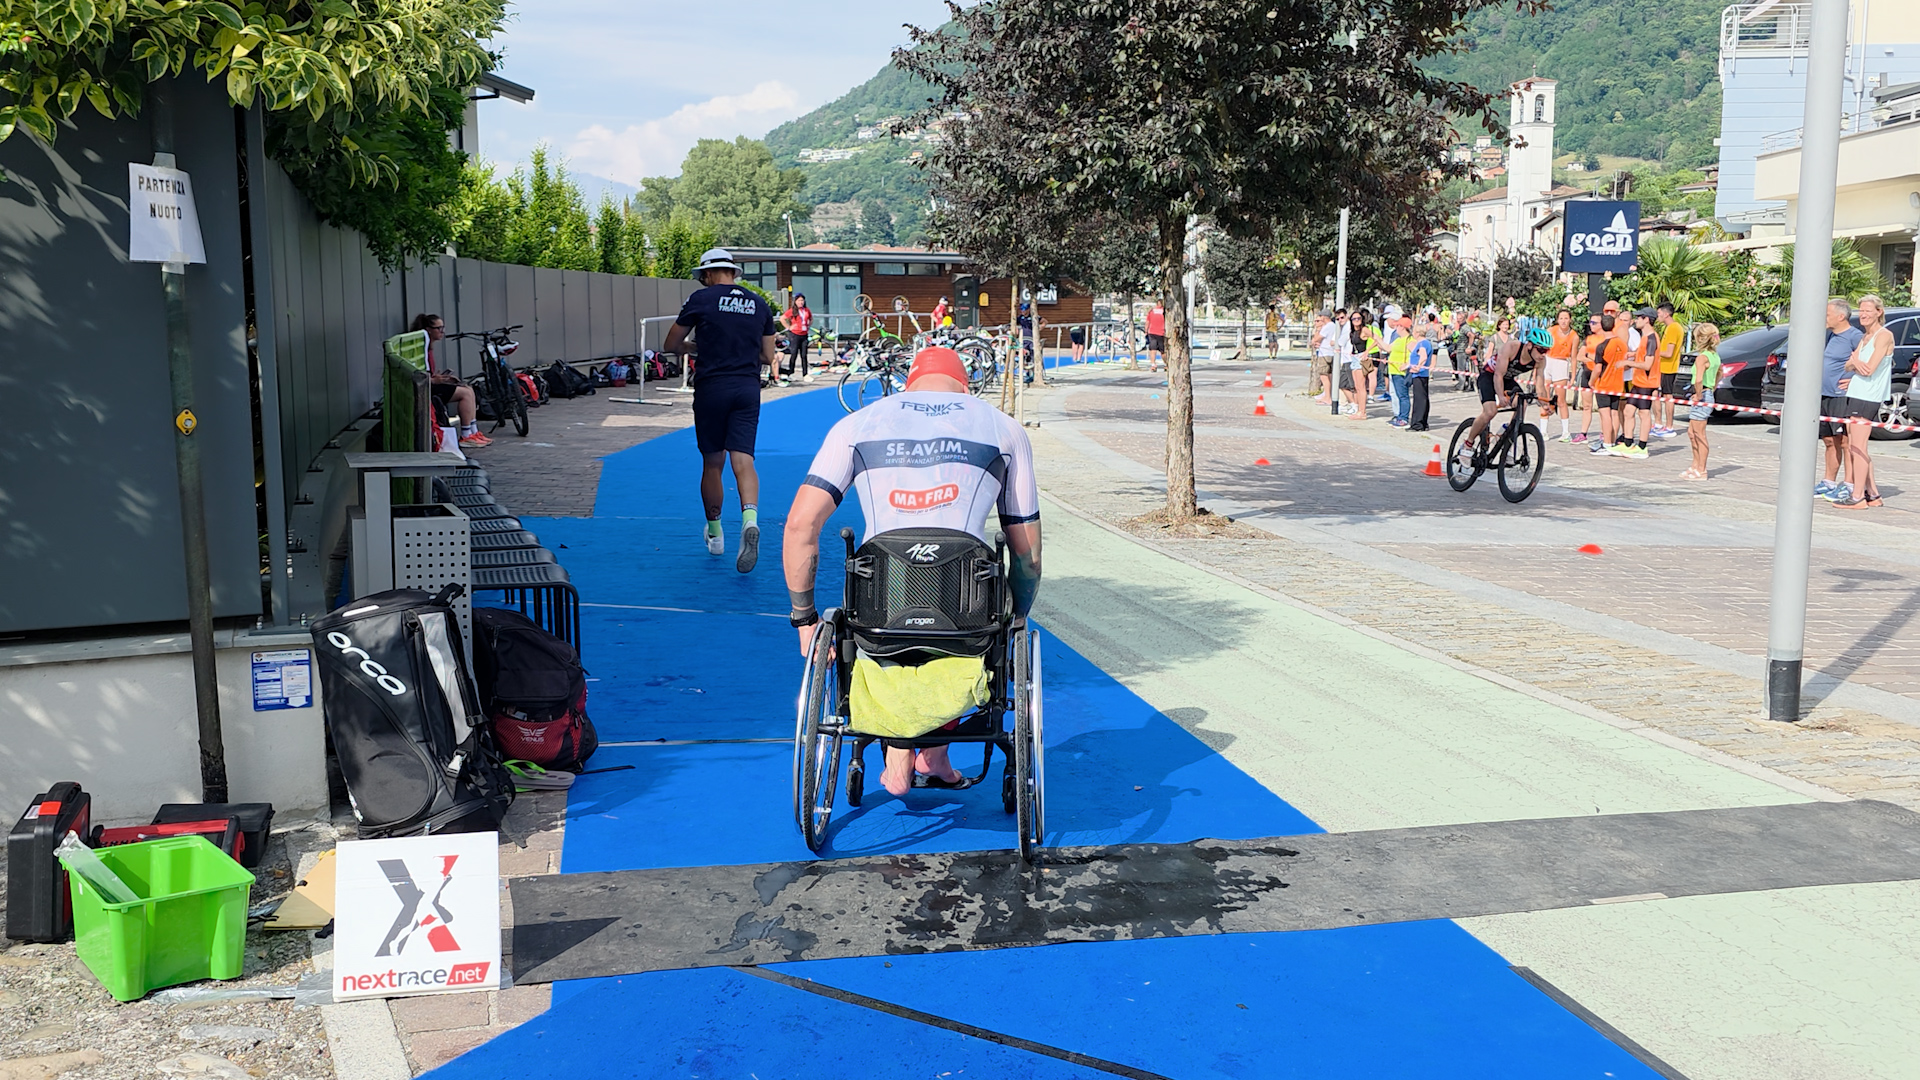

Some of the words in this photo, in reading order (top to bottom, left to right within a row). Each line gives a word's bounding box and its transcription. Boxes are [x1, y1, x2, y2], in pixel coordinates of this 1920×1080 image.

[138, 175, 186, 195] PARTENZA
[149, 203, 182, 220] NUOTO
[1570, 232, 1633, 256] goen
[1022, 288, 1057, 301] GEN
[718, 296, 756, 309] ITALIA
[718, 305, 756, 315] TRIATHLON
[900, 401, 965, 413] FENIKS
[885, 440, 968, 457] SE.AV.IM.
[905, 617, 935, 626] progeo
[326, 631, 407, 696] orca
